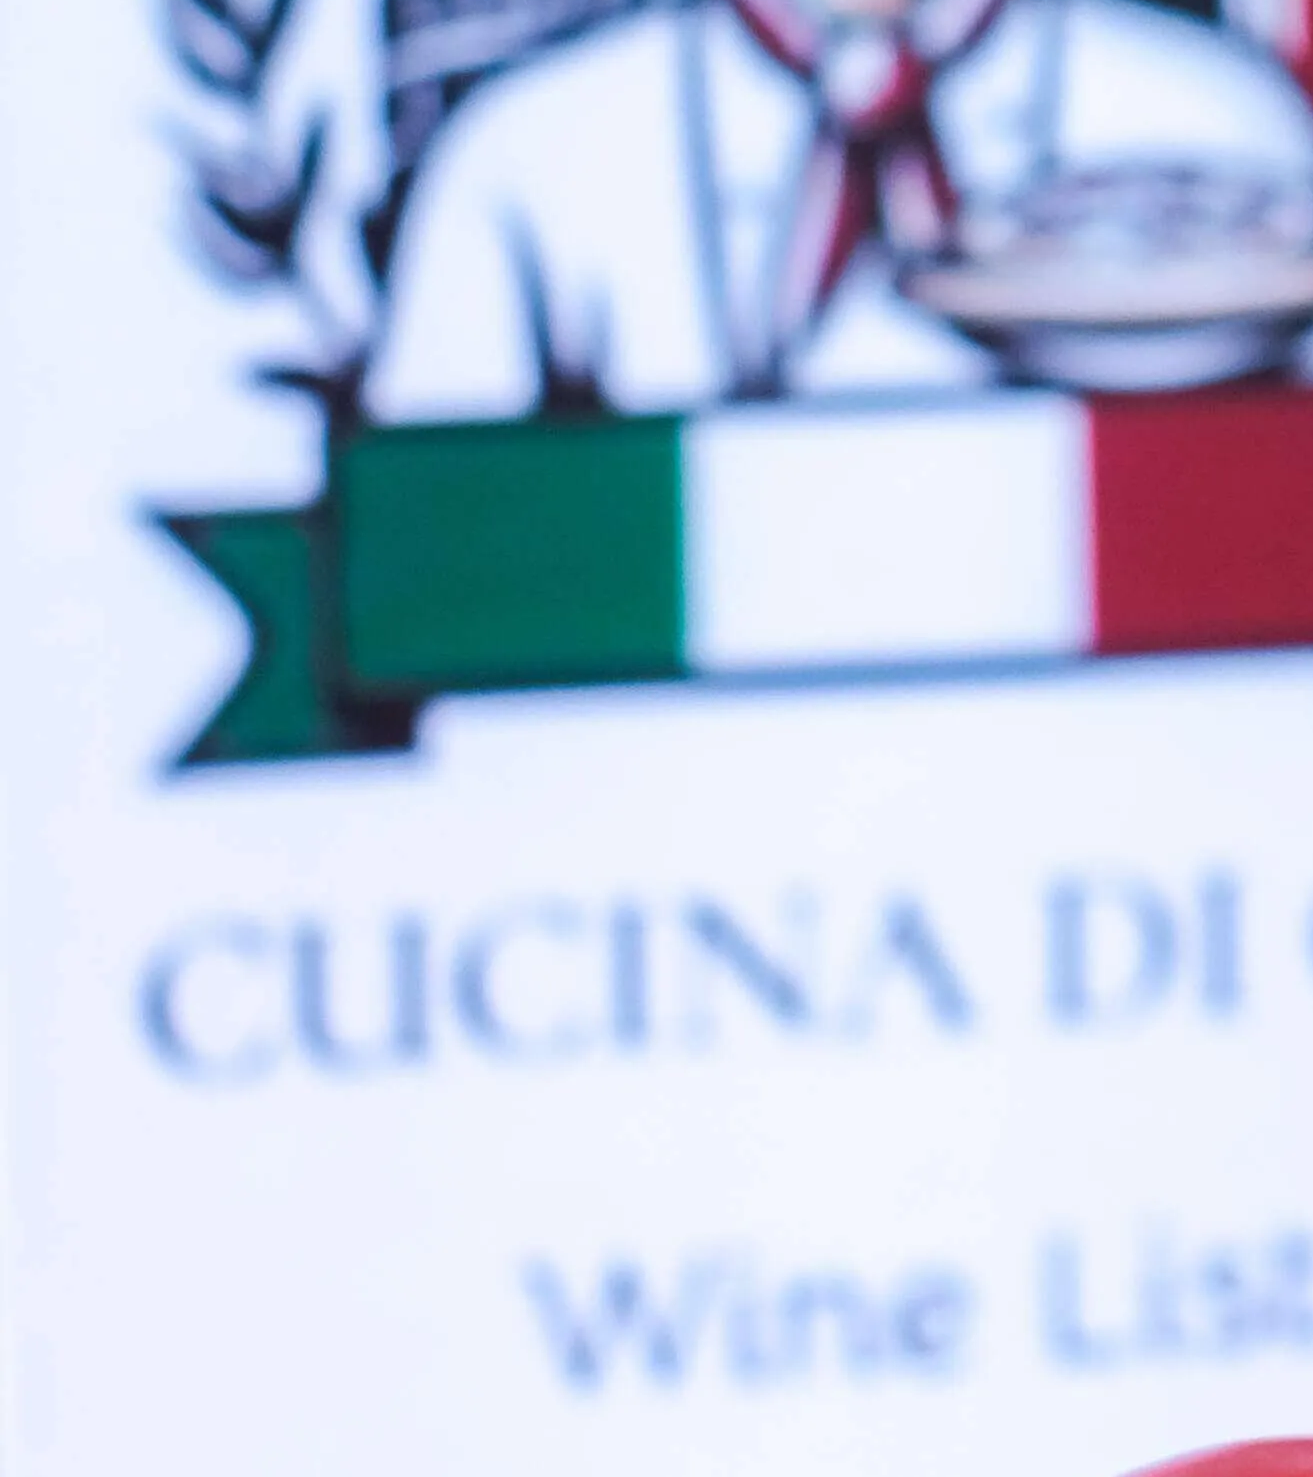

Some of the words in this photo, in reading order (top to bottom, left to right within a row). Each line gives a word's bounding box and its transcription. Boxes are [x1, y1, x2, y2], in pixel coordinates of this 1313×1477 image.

[135, 885, 975, 1090] CUCINA
[1045, 863, 1245, 1030] DI
[525, 1240, 975, 1390] Wine
